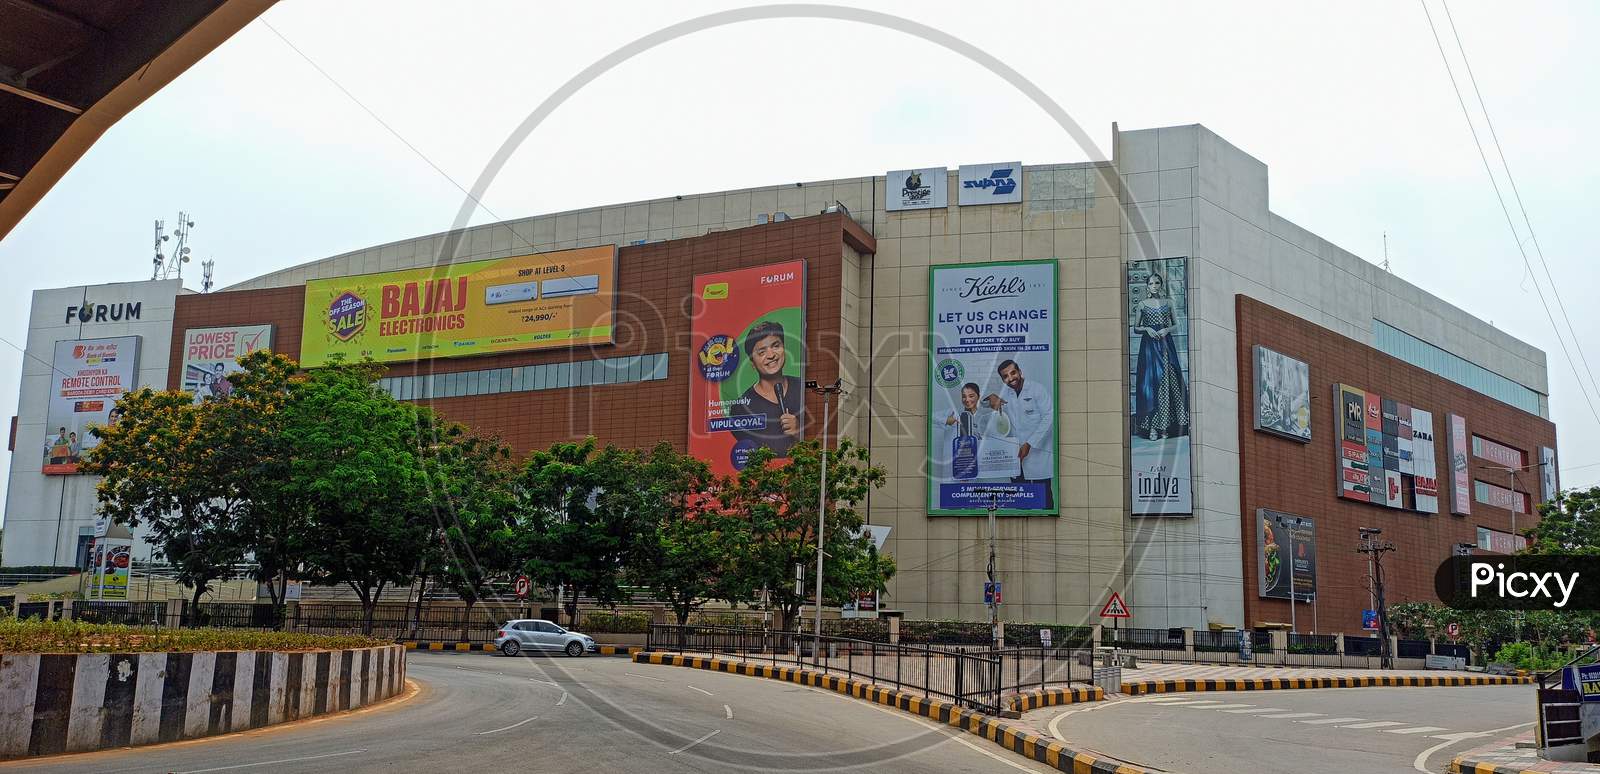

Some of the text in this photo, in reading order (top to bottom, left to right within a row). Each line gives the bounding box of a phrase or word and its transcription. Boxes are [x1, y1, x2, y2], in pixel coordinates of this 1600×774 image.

[518, 268, 533, 277] SHOP
[535, 267, 541, 275] AT
[760, 272, 794, 284] FORUM
[960, 275, 1026, 300] Kiehl's
[341, 297, 352, 306] THE
[381, 276, 468, 319] BAJAJ
[65, 301, 142, 325] FORUM
[329, 299, 365, 317] OFF SEASON
[329, 309, 365, 333] SALE
[938, 309, 1048, 323] LET US CHANGE
[379, 314, 465, 337] ELECTRONICS
[956, 322, 1029, 335] YOUR SKIN
[189, 331, 238, 344] LOWEST
[188, 343, 236, 360] PRICE
[62, 375, 121, 389] REMOTE CONTROL
[708, 396, 752, 408] Humorously
[1348, 401, 1362, 421] PVR
[710, 417, 763, 429] VIPUL GOYAL
[1413, 430, 1433, 441] ZARA
[1138, 472, 1179, 498] indya
[1583, 682, 1600, 694] RA
